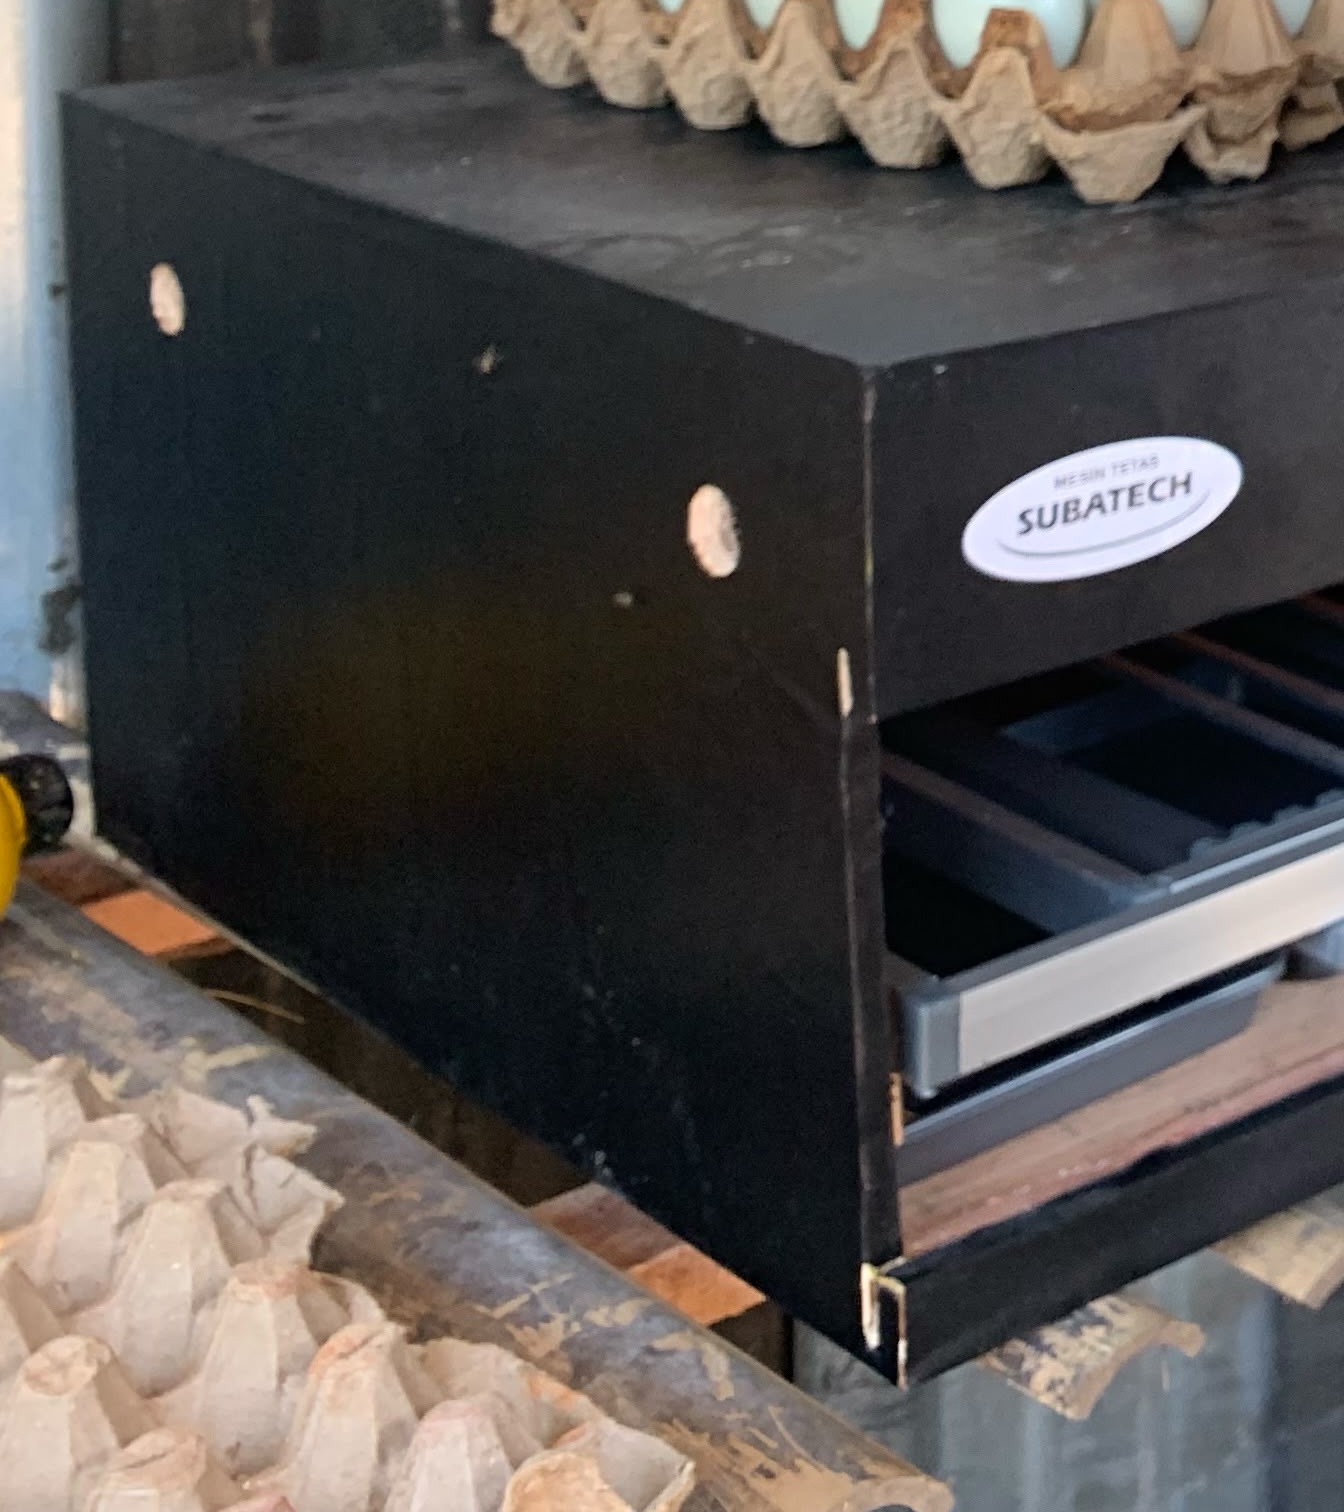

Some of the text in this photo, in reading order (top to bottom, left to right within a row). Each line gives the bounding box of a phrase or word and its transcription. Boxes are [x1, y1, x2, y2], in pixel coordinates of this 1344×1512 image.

[1053, 455, 1160, 490] MESIN TETAS
[1016, 471, 1193, 536] SUBATECH
